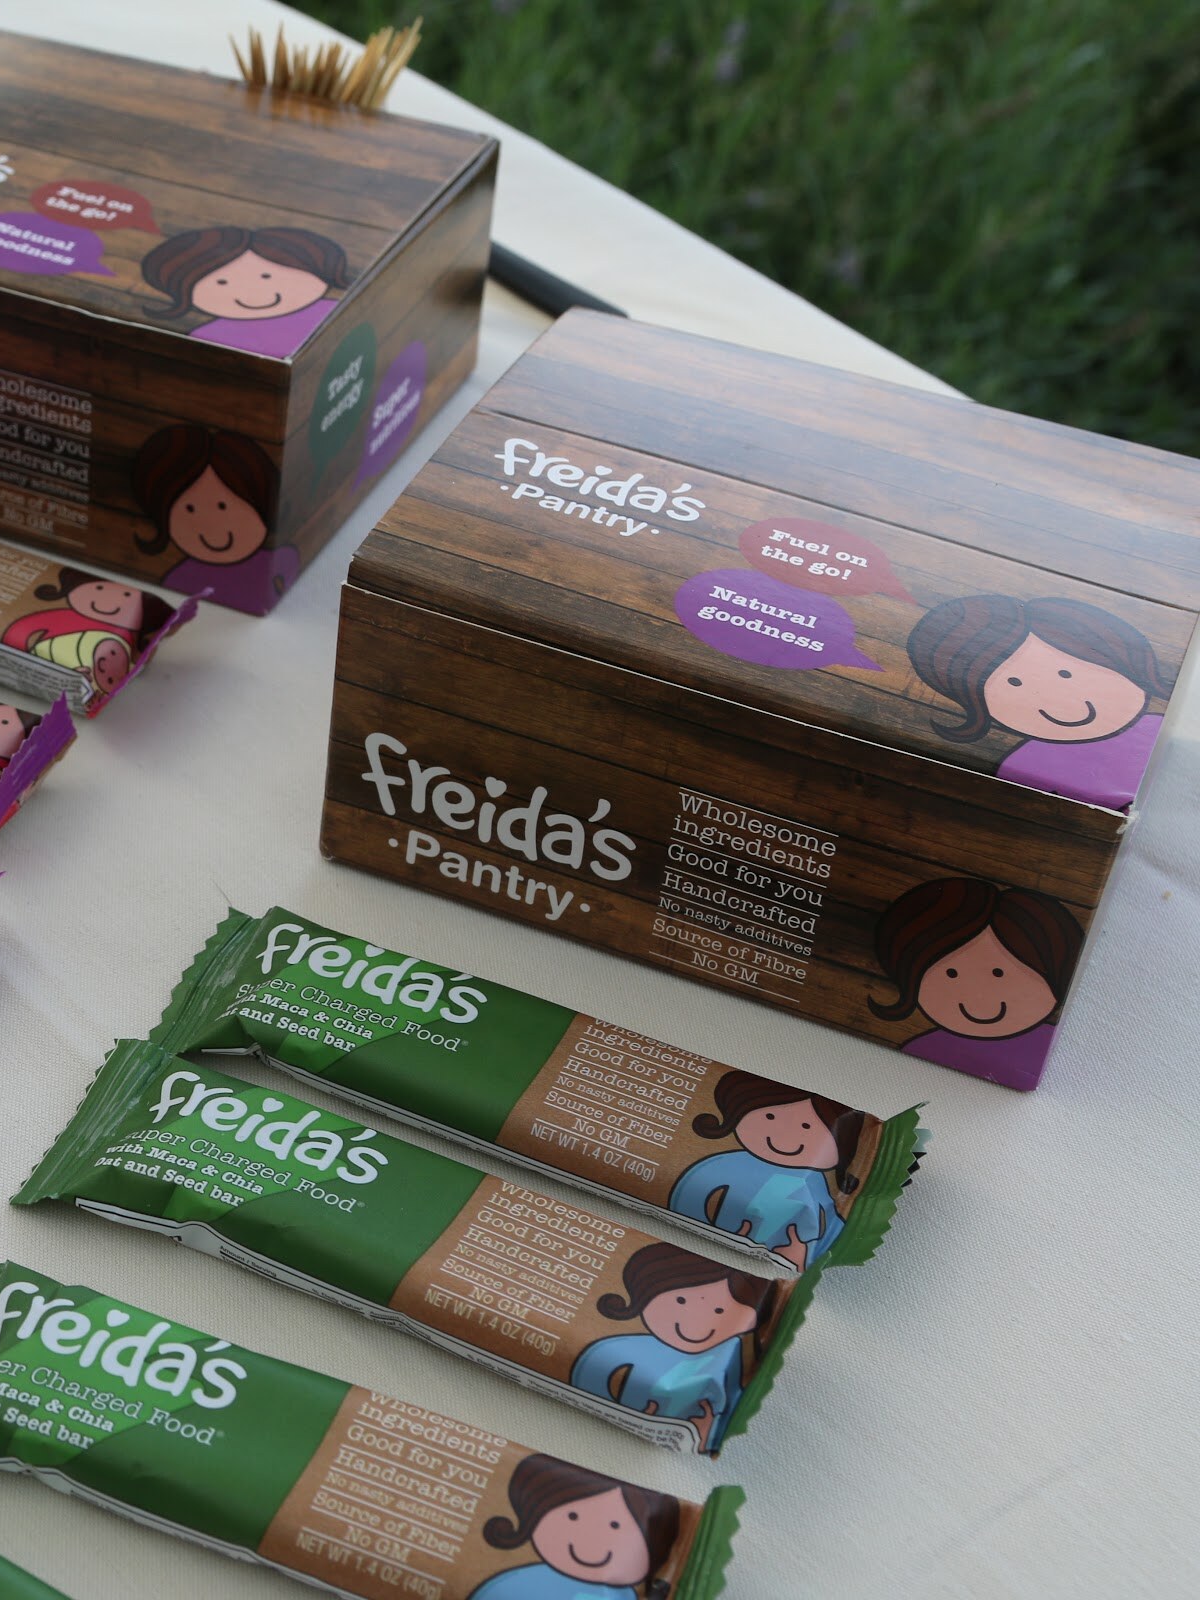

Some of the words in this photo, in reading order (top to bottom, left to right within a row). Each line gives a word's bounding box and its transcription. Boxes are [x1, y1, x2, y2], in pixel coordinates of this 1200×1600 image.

[45, 197, 81, 212] the
[79, 206, 117, 222] go!
[56, 186, 106, 206] Fuel
[106, 199, 134, 213] on
[23, 426, 52, 447] for
[54, 436, 90, 459] you
[494, 437, 707, 522] freida's
[760, 545, 805, 566] the
[807, 561, 852, 581] go!
[768, 529, 830, 556] Fuel
[834, 550, 868, 568] on
[697, 605, 825, 653] goodness
[708, 585, 818, 630] Natural
[361, 732, 637, 882] freida's
[678, 791, 837, 857] Wholesome
[667, 843, 729, 876] Good
[733, 865, 772, 890] for
[774, 879, 823, 907] you
[672, 814, 832, 880] ingredients
[657, 896, 681, 912] No
[684, 905, 732, 931] nasty
[734, 922, 813, 957] additives
[661, 870, 817, 935] Handcrafted
[255, 922, 488, 1025] freida's
[652, 918, 723, 949] Source
[727, 945, 751, 960] of
[751, 950, 807, 981] Fibre
[690, 950, 719, 971] No
[723, 962, 760, 985] GM
[239, 1006, 276, 1025] and
[276, 1016, 320, 1042] Seed
[324, 1034, 358, 1053] bar
[259, 993, 310, 1018] Maca
[312, 1011, 330, 1025] &
[332, 1017, 374, 1041] Chia
[300, 983, 399, 1030] Charged
[148, 1070, 389, 1185] freida's
[105, 1142, 144, 1155] with
[145, 1146, 198, 1171] Maca
[201, 1164, 220, 1178] &
[220, 1171, 265, 1197] Chia
[123, 1160, 162, 1179] and
[161, 1168, 209, 1194] Seed
[209, 1185, 245, 1208] bar
[188, 1138, 292, 1188] Charged
[487, 1192, 619, 1252] ingredients
[501, 1180, 626, 1240] Wholesome
[463, 1226, 595, 1291] Handcrafted
[476, 1210, 528, 1239] Good
[530, 1229, 564, 1251] for
[562, 1248, 605, 1271] you
[441, 1257, 504, 1290] Source
[505, 1285, 529, 1300] of
[526, 1292, 577, 1321] Fiber
[453, 1243, 475, 1258] No
[475, 1253, 518, 1276] nasty
[518, 1269, 585, 1305] additives
[424, 1287, 454, 1310] NET
[452, 1300, 477, 1320] WT
[478, 1310, 499, 1330] 1.4
[500, 1320, 523, 1340] OZ
[520, 1330, 557, 1357] (40g)
[468, 1286, 495, 1305] No
[496, 1297, 531, 1320] GM
[30, 1364, 144, 1420] Charged
[44, 1399, 65, 1414] &
[67, 1406, 116, 1434] Chia
[3, 1407, 54, 1437] Seed
[57, 1424, 95, 1451] bar
